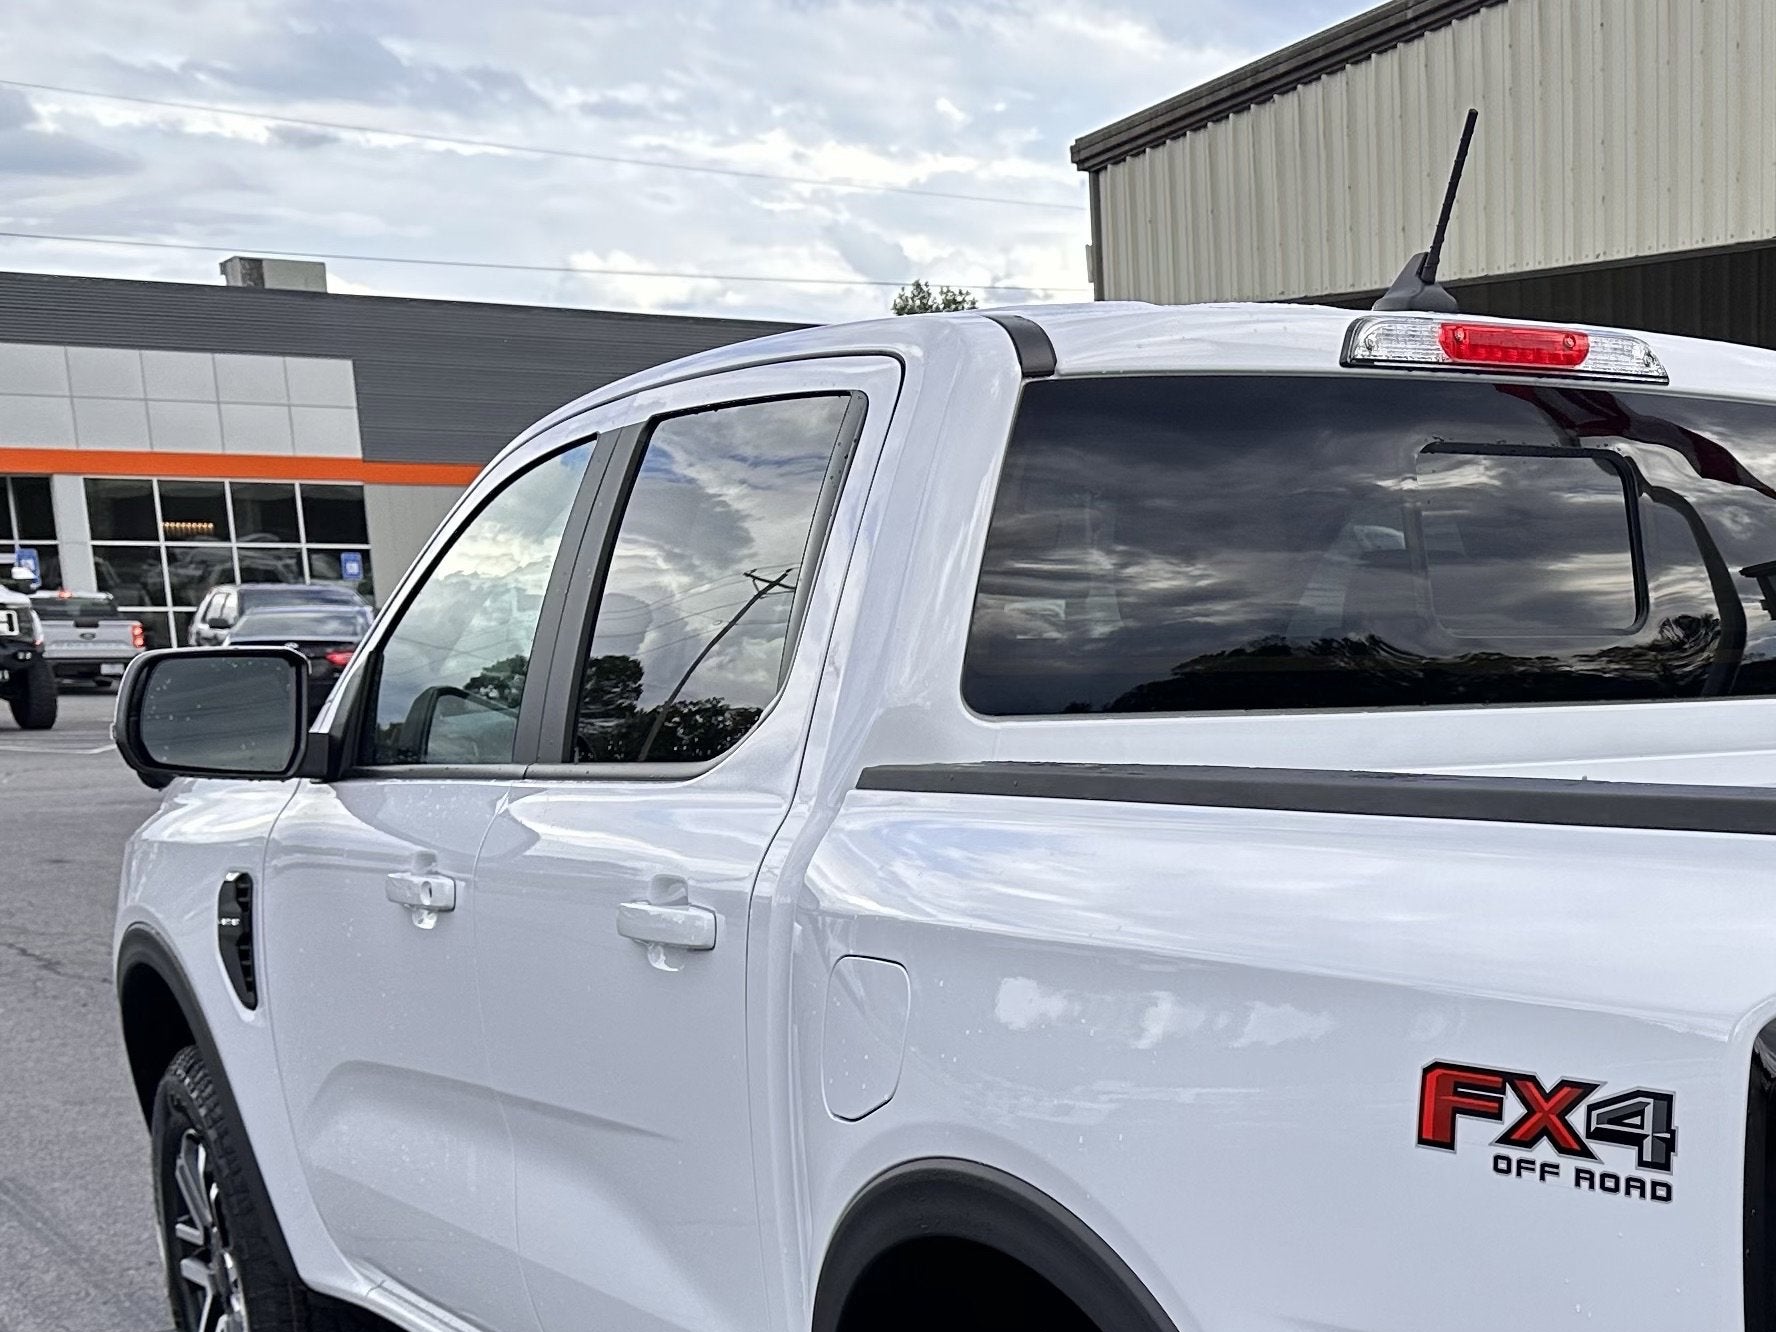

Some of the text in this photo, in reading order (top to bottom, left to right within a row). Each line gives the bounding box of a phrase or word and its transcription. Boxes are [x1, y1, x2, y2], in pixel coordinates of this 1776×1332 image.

[1416, 1058, 1678, 1176] FX4
[1492, 1153, 1674, 1203] OFF ROAD
